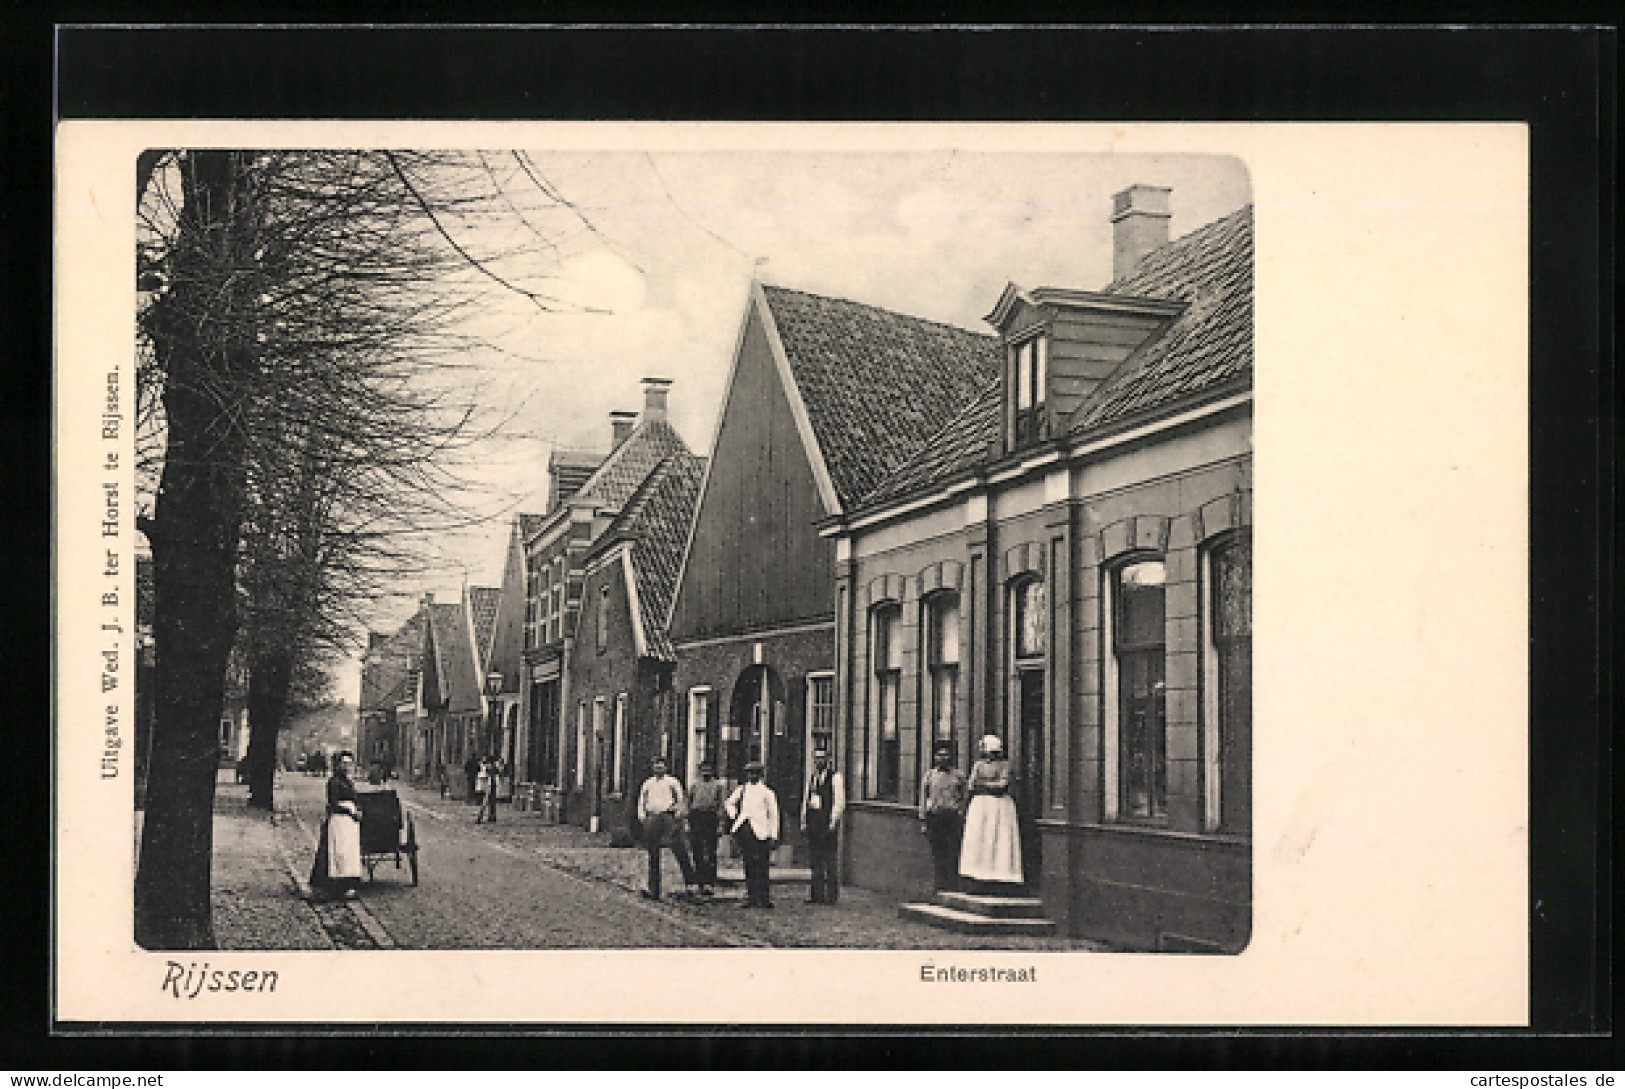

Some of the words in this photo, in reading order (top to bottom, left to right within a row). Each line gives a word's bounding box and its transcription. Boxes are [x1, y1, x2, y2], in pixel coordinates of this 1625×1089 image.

[101, 364, 123, 439] Rijssen.
[102, 452, 119, 471] te
[101, 482, 119, 537] Horst
[102, 549, 119, 576] ter
[101, 586, 119, 607] B.
[101, 616, 123, 634] J.
[101, 642, 119, 694] Wed.
[101, 705, 122, 780] Uitgave
[162, 960, 279, 1000] Rijssen
[920, 965, 1037, 982] Enterstraat
